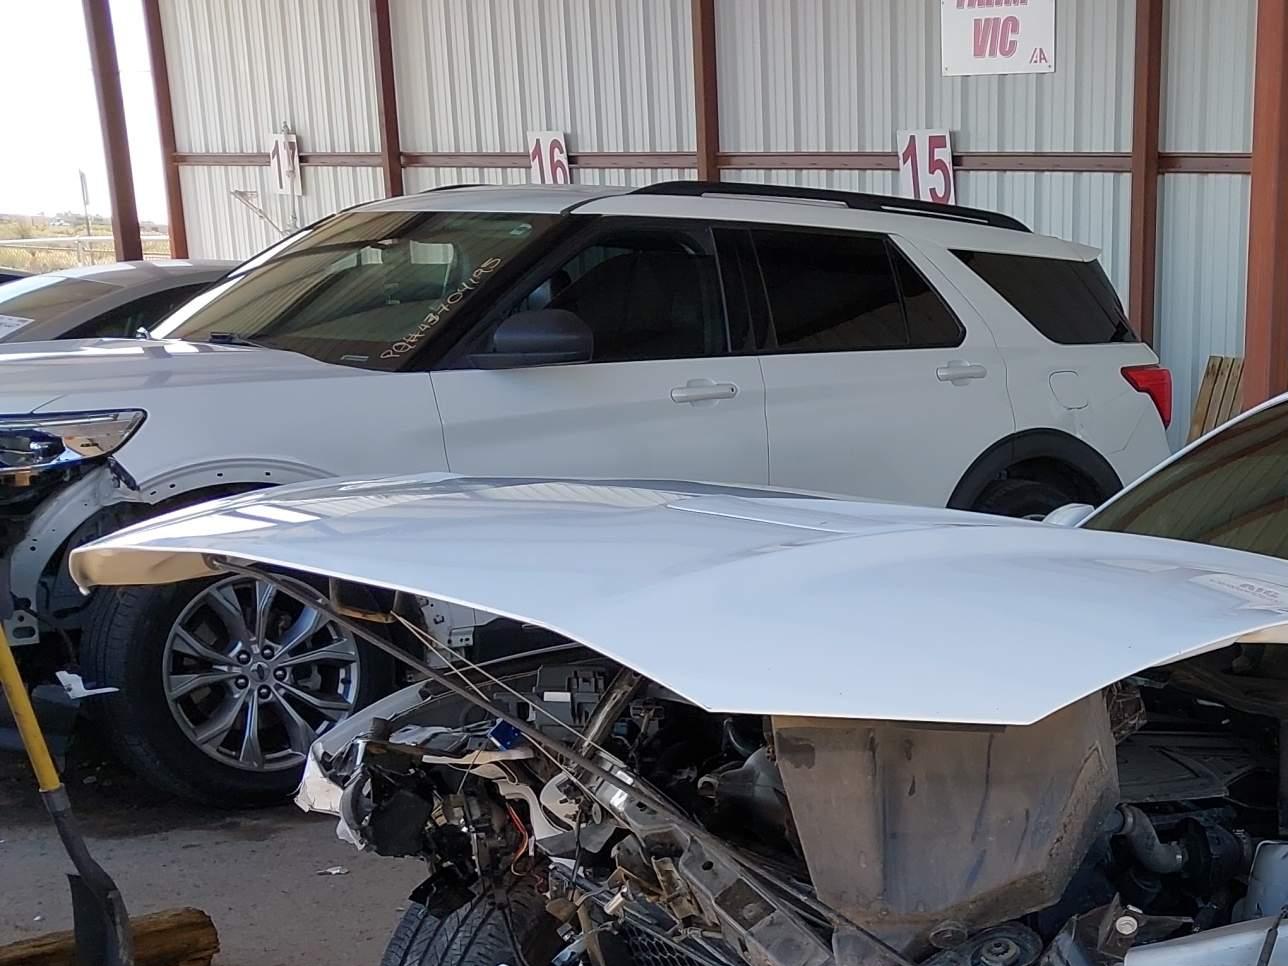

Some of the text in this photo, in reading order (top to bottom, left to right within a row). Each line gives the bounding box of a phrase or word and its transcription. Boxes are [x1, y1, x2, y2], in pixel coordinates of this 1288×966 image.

[973, 15, 1020, 58] VIC
[531, 138, 569, 185] 16
[902, 134, 952, 205] 15
